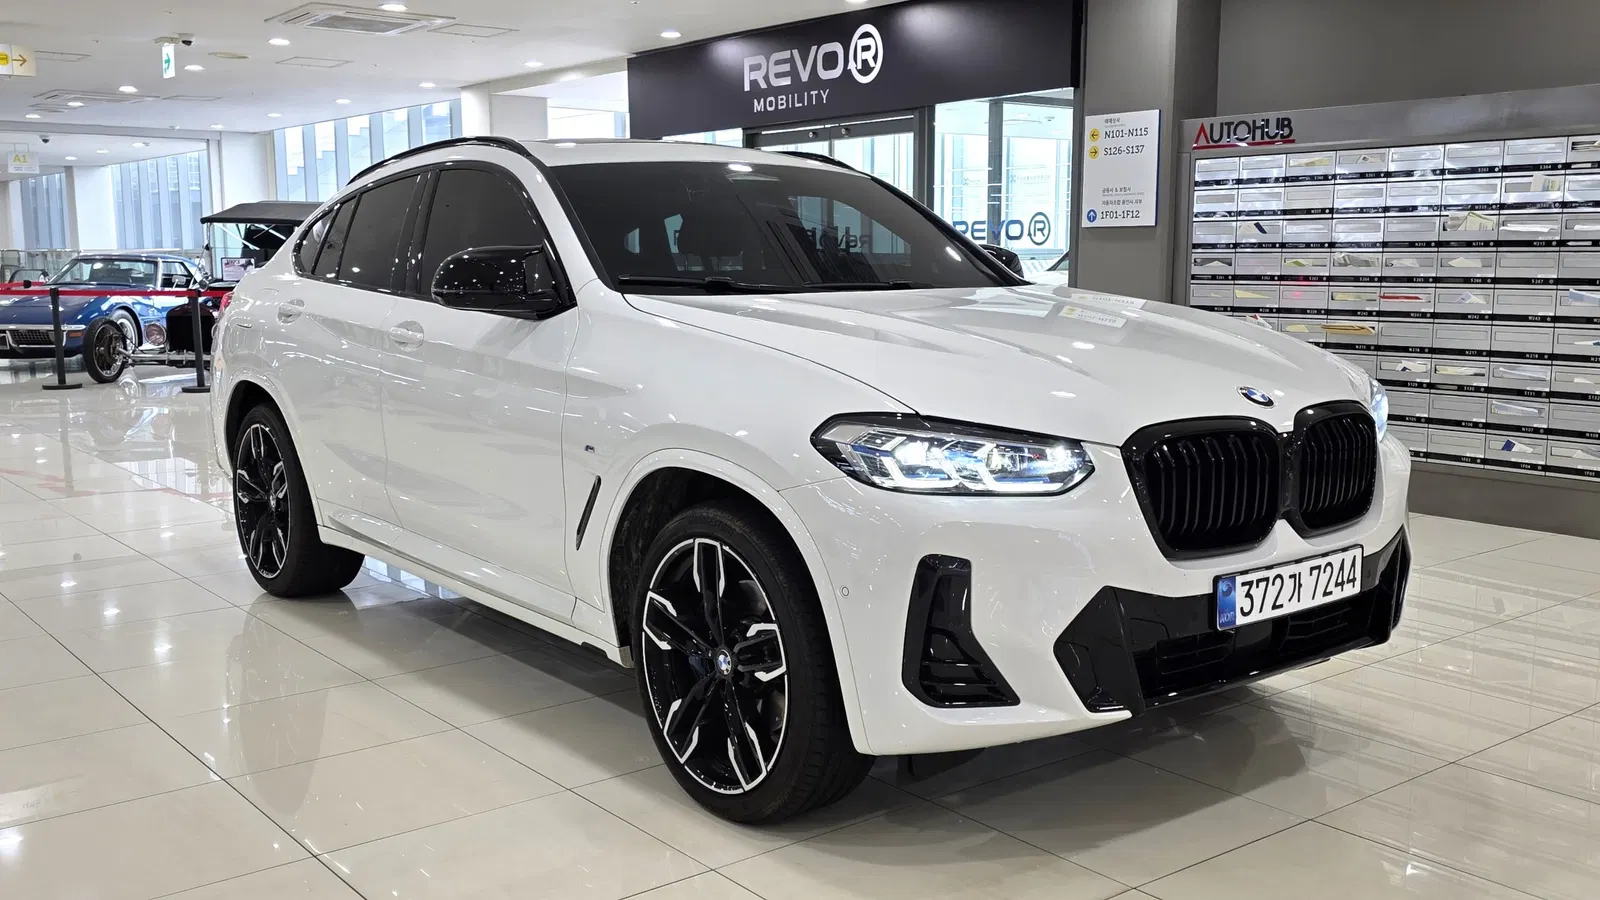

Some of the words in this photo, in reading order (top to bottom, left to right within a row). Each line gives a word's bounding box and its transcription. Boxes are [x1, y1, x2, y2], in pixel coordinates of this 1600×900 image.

[743, 41, 844, 92] REVO
[753, 89, 830, 113] MOBILITY
[1104, 127, 1149, 139] N101-N115
[1193, 117, 1294, 145] AUTOHUB
[13, 154, 28, 163] A1
[1104, 145, 1145, 156] S126-S137
[1101, 210, 1140, 219] 1F01-1F12
[952, 220, 1024, 241] REVO
[1240, 572, 1302, 617] 372가
[1309, 555, 1356, 600] 7244
